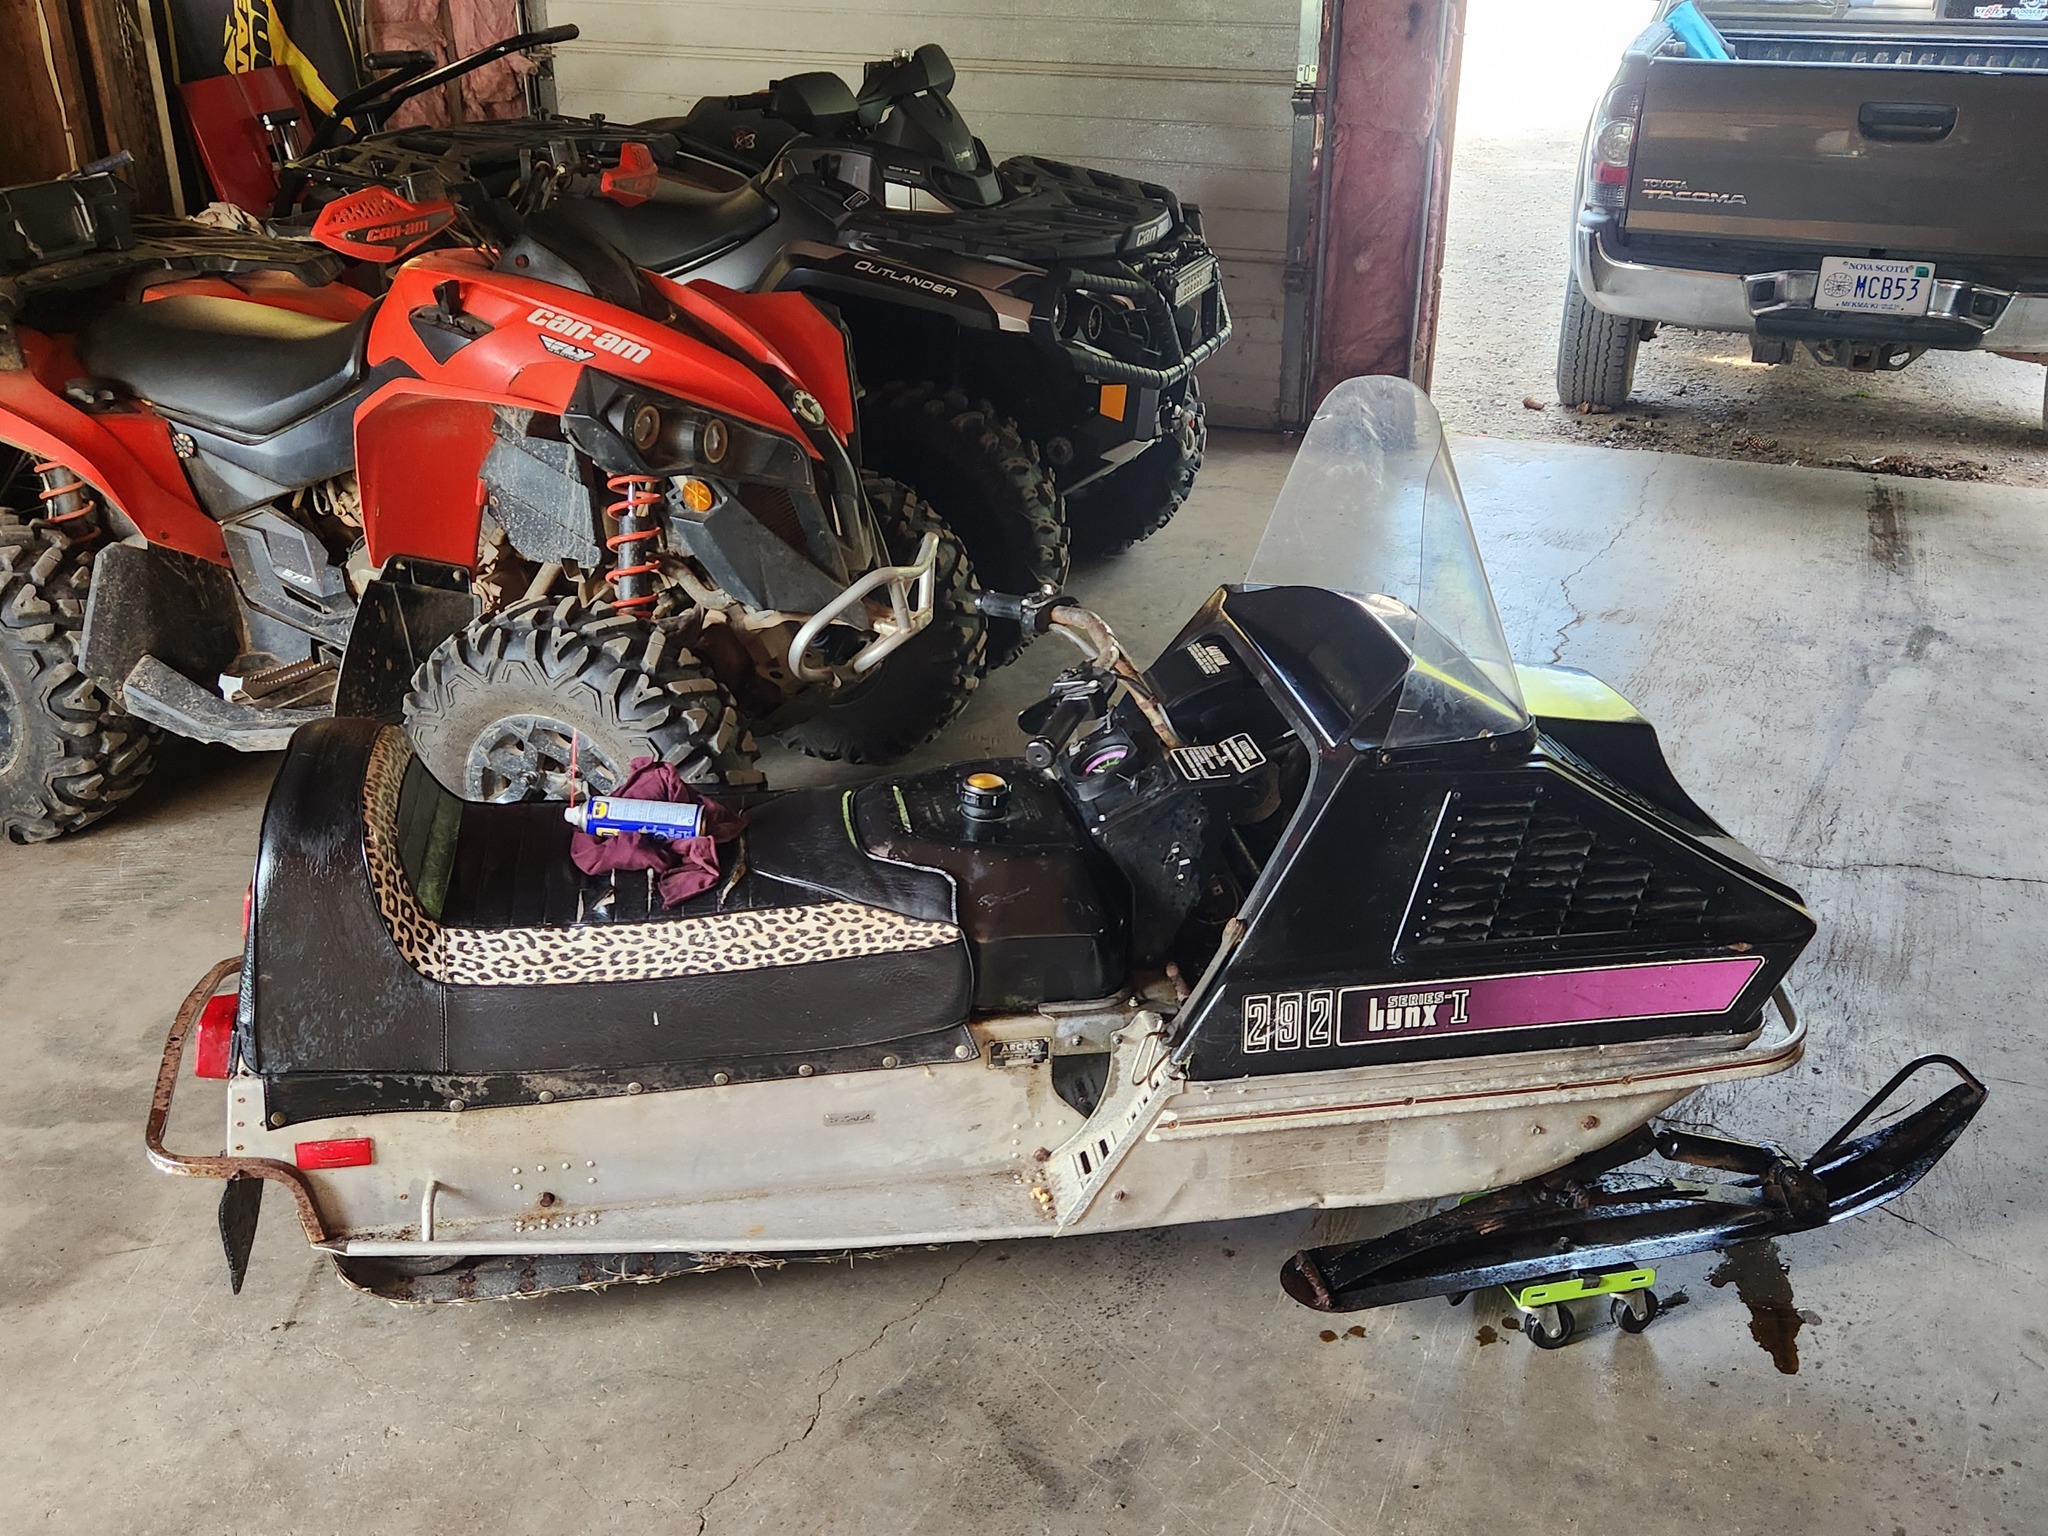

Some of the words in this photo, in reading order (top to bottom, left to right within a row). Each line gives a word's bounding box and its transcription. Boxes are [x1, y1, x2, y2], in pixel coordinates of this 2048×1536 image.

[1643, 179, 1687, 189] TOYOTA
[1642, 189, 1747, 204] TACOMA
[366, 220, 429, 242] can-am
[1848, 262, 1873, 271] NOVA
[1874, 264, 1910, 274] SCOTIA
[1853, 275, 1920, 301] MCB53
[527, 308, 651, 364] can-am
[1247, 996, 1330, 1048] 292
